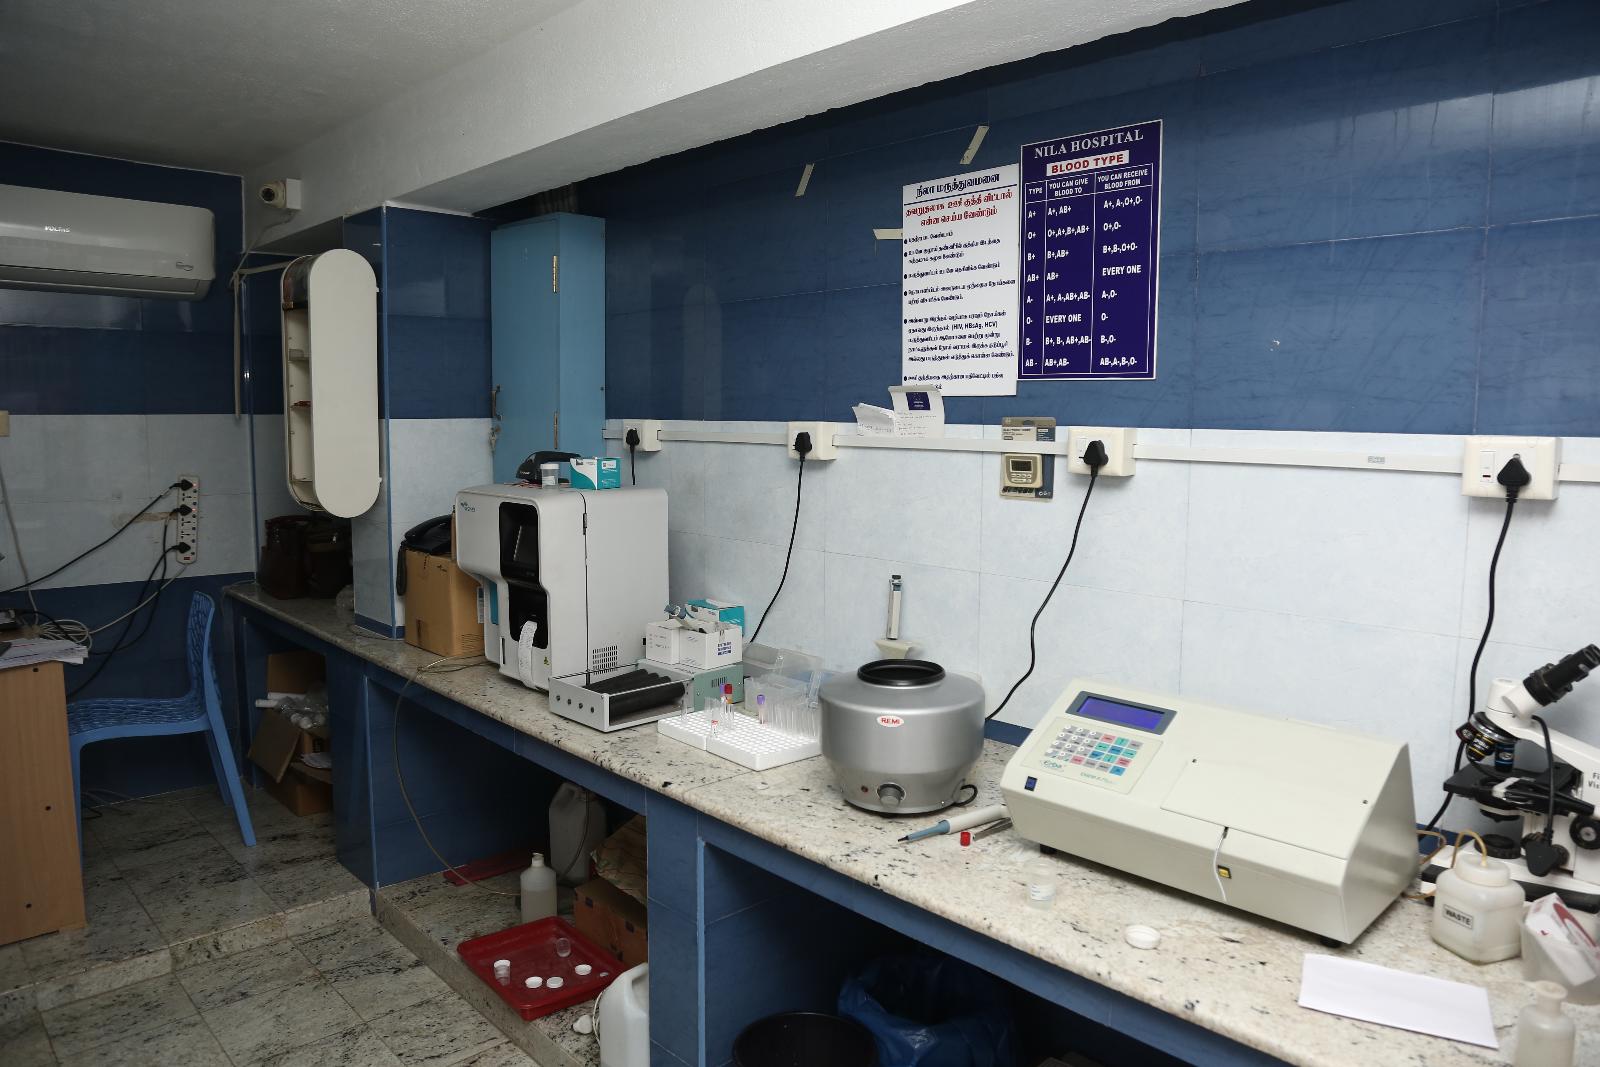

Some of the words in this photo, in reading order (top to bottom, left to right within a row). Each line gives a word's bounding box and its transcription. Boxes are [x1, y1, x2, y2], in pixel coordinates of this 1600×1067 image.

[1034, 143, 1067, 158] NILA
[1070, 129, 1144, 152] HOSPITAL
[1051, 160, 1089, 174] BLOOD
[1093, 154, 1124, 166] TYPE
[1123, 169, 1148, 179] RECEIVE
[1104, 181, 1123, 189] BLOOD
[1054, 189, 1074, 197] BLOOD
[1059, 206, 1071, 214] AB+
[1102, 266, 1125, 276] EVERY
[1126, 265, 1141, 273] ONE
[1027, 274, 1039, 282] AB+
[1046, 272, 1059, 280] AB+
[1046, 315, 1066, 324] EVERY
[1068, 314, 1081, 322] ONE
[1101, 313, 1108, 321] O-
[1446, 910, 1470, 926] WASTE
